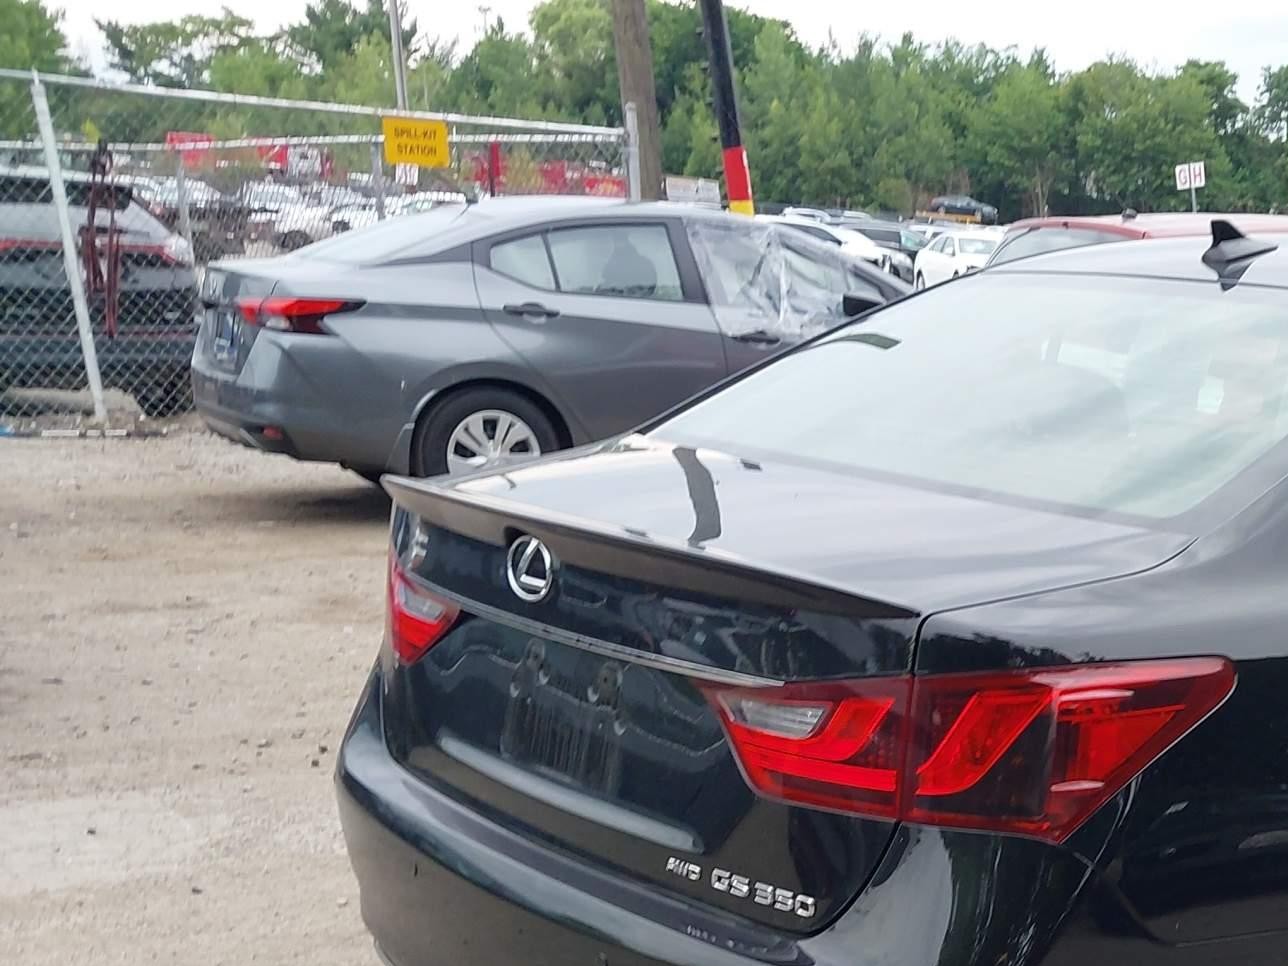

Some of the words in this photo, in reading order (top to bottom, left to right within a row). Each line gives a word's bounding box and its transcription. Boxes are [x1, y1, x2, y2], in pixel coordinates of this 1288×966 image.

[393, 126, 437, 140] SPILL-KIT
[397, 143, 438, 157] STATION
[711, 867, 750, 898] GS
[753, 881, 816, 918] 350
